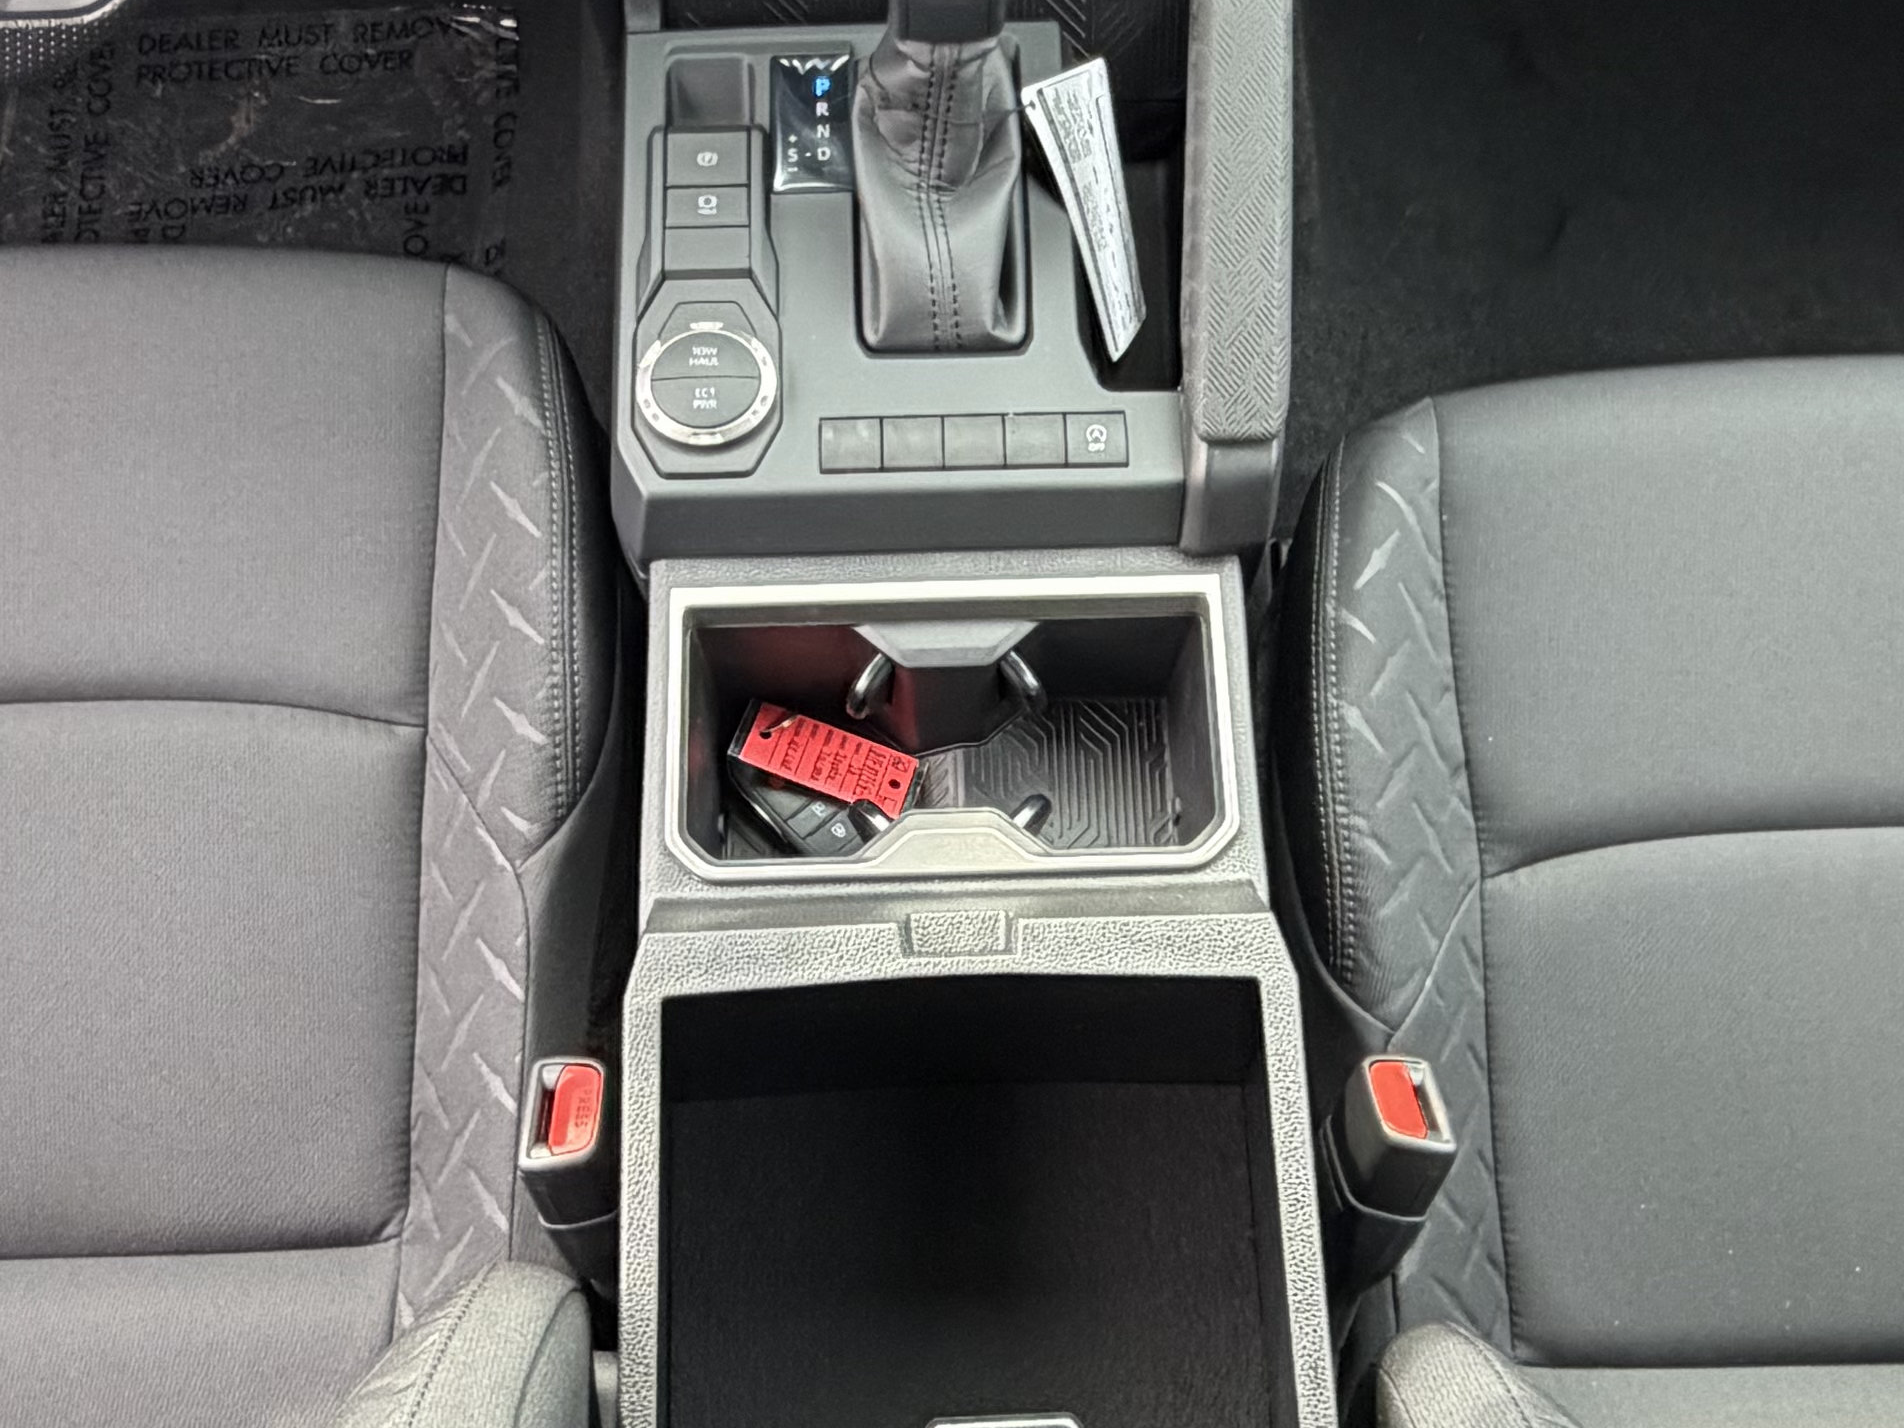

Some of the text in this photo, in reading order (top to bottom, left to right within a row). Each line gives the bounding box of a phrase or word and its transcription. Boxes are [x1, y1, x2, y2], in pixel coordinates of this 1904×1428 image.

[138, 15, 458, 56] DEALER MUST REMOV
[320, 50, 415, 76] COVER
[816, 76, 831, 97] P
[816, 101, 829, 117] R
[817, 124, 830, 139] N
[787, 146, 831, 163] S D
[365, 173, 469, 200] DEALER
[129, 196, 249, 218] REMOVE
